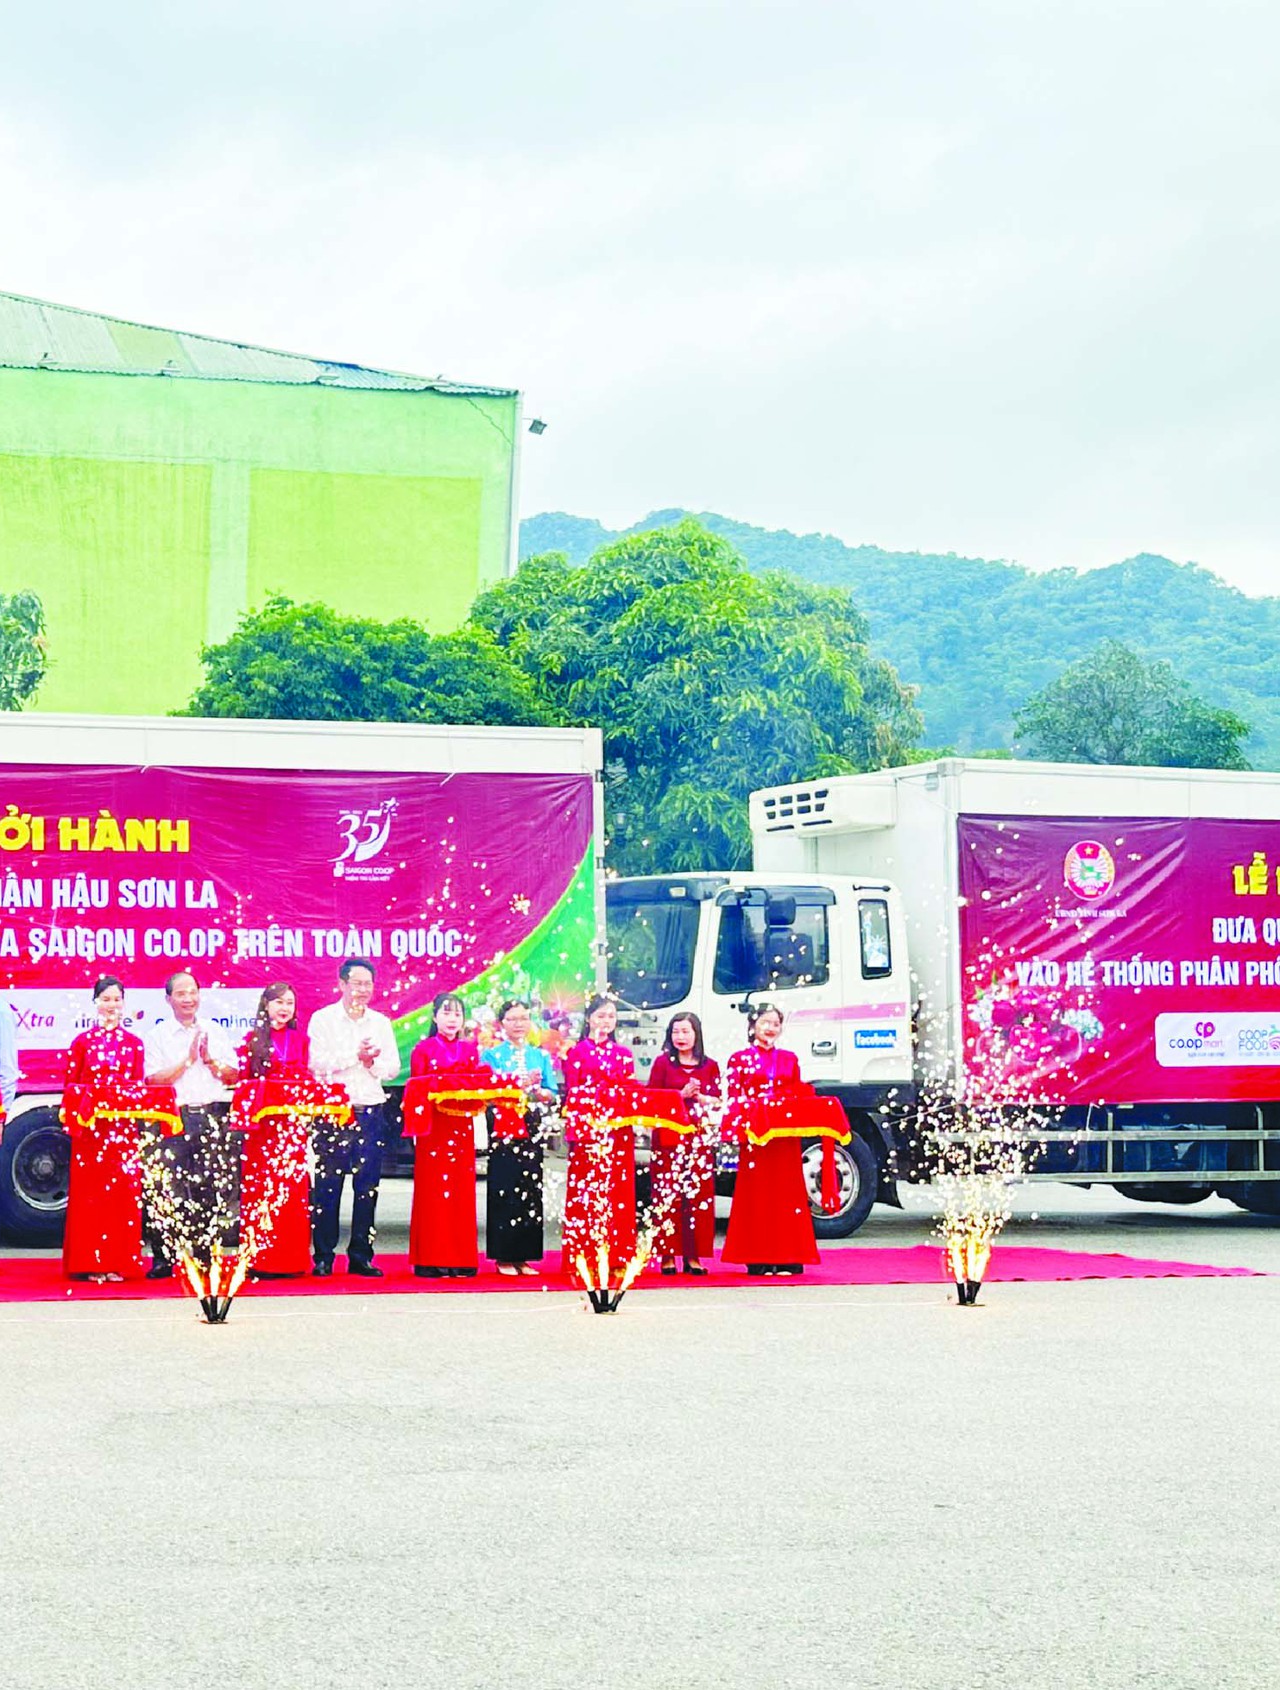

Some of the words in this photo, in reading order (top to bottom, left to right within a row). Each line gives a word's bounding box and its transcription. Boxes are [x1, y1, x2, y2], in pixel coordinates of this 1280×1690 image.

[58, 809, 190, 853] HÀNH
[52, 872, 109, 914] HẬU
[119, 876, 177, 908] SƠN
[185, 880, 218, 909] LA
[1232, 852, 1269, 896] LỄ
[29, 926, 135, 958] SAIGON
[144, 928, 226, 957] CO.OP
[233, 923, 304, 957] TRÊN
[311, 924, 383, 957] TOÀN
[390, 920, 462, 961] QUỐC
[1213, 916, 1257, 943] ĐƯA
[1015, 956, 1060, 986] VÀO
[1101, 952, 1173, 986] THỐNG
[1180, 955, 1239, 986] PHÂN
